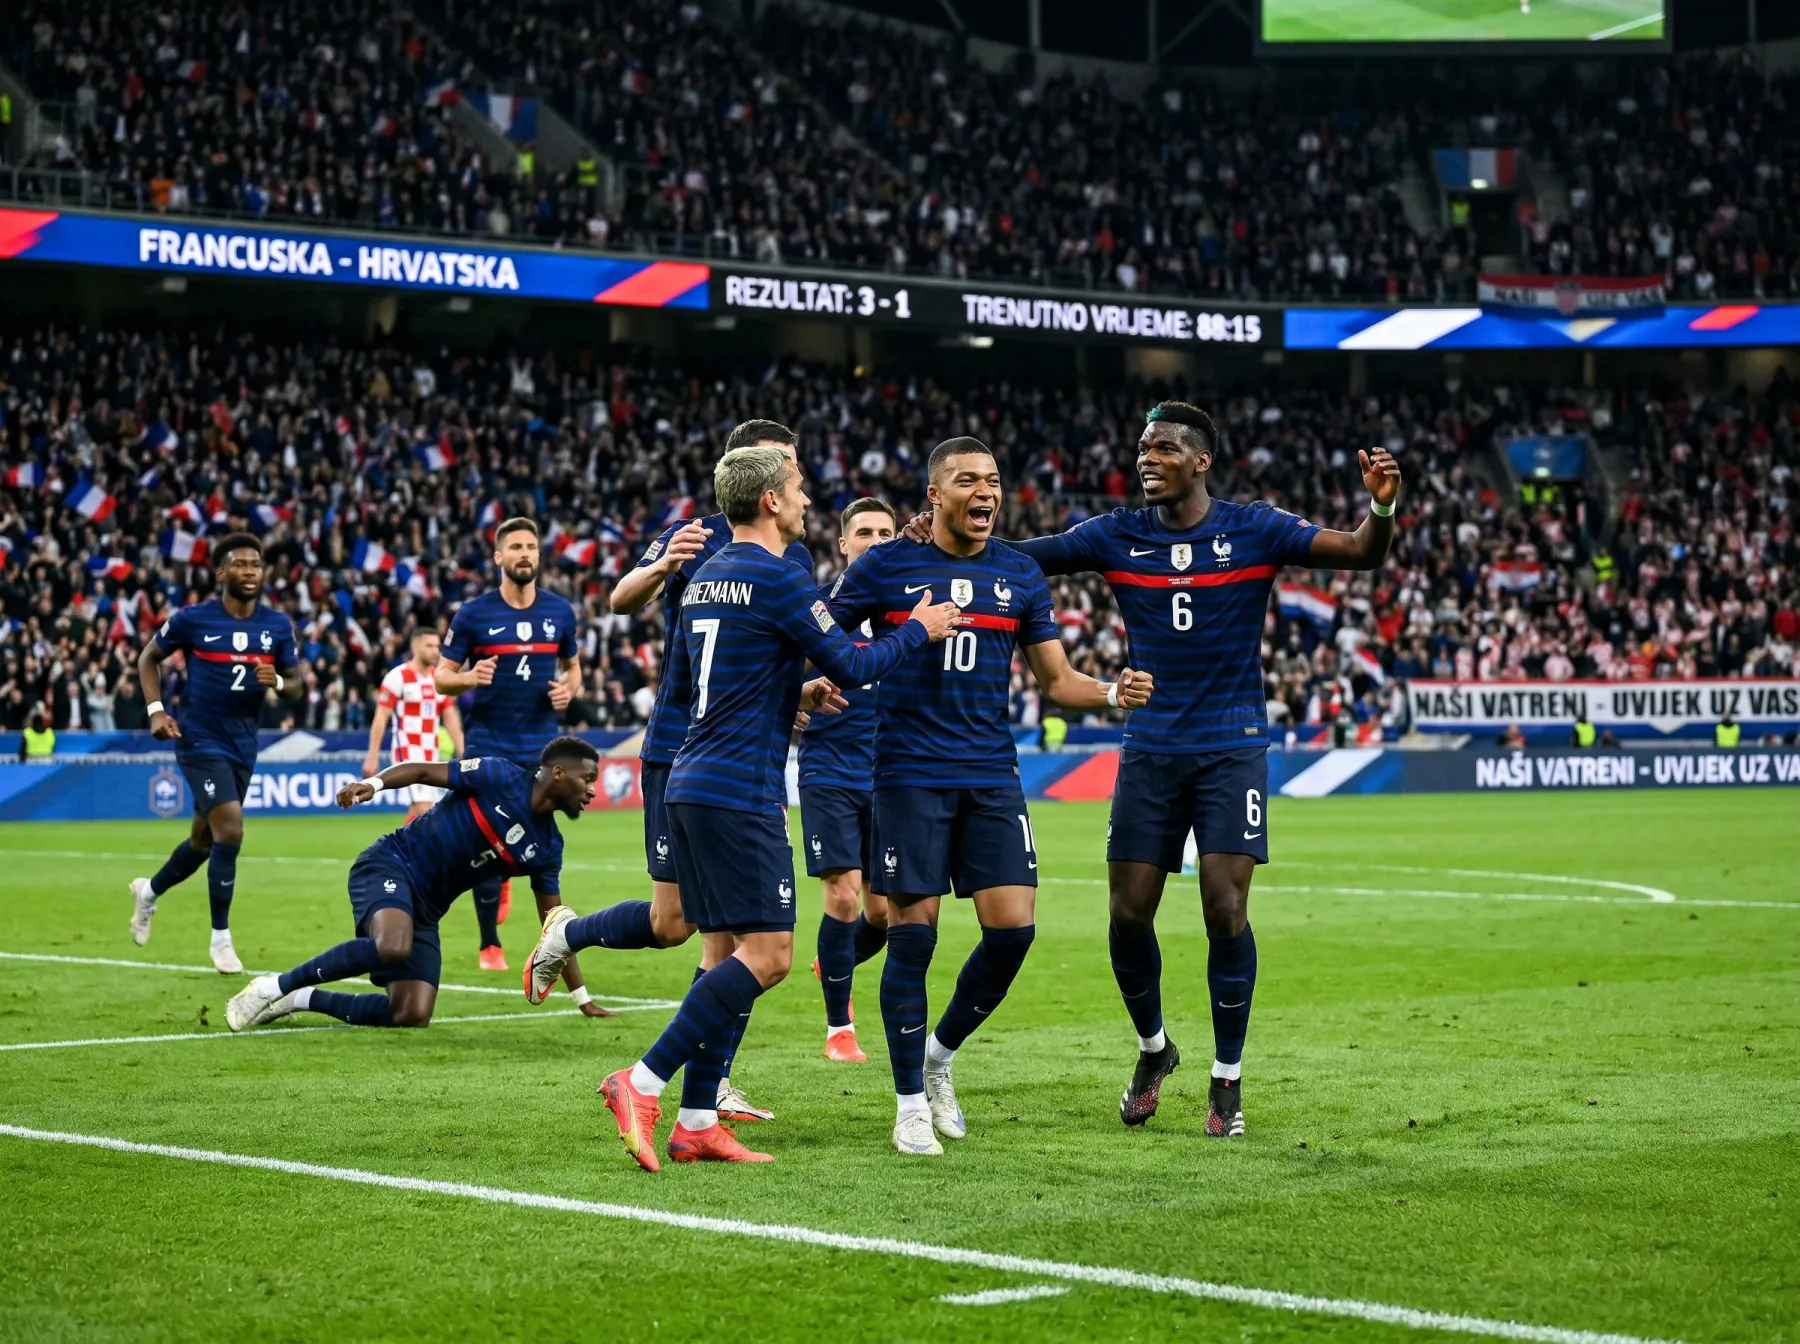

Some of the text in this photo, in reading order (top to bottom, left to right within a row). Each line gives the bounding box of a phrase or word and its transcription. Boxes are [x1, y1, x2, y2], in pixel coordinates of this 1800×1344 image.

[139, 228, 520, 291] FRANCUSKA - HRVATSKA
[725, 275, 911, 319] REZULTAT: 3 - 1
[962, 294, 1088, 333] TRENUTNO
[1090, 304, 1194, 340] VRIJEME:
[1171, 592, 1193, 631] 6
[515, 654, 532, 681] 4
[691, 618, 721, 719] 7
[943, 631, 977, 672] 10
[230, 664, 247, 691] 2
[1415, 687, 1473, 718] NAŠI
[1481, 692, 1587, 718] VATRENI
[1613, 690, 1703, 717] UVIJEK
[1710, 689, 1742, 716] UZ
[1748, 688, 1799, 716] VAS
[1476, 751, 1533, 788] NAŠI
[1536, 756, 1635, 787] VATRENI
[1654, 754, 1736, 784] UVIJEK
[1739, 754, 1771, 783] UZ
[1246, 788, 1261, 827] 6
[1017, 814, 1037, 854] 1
[470, 848, 498, 869] 5
